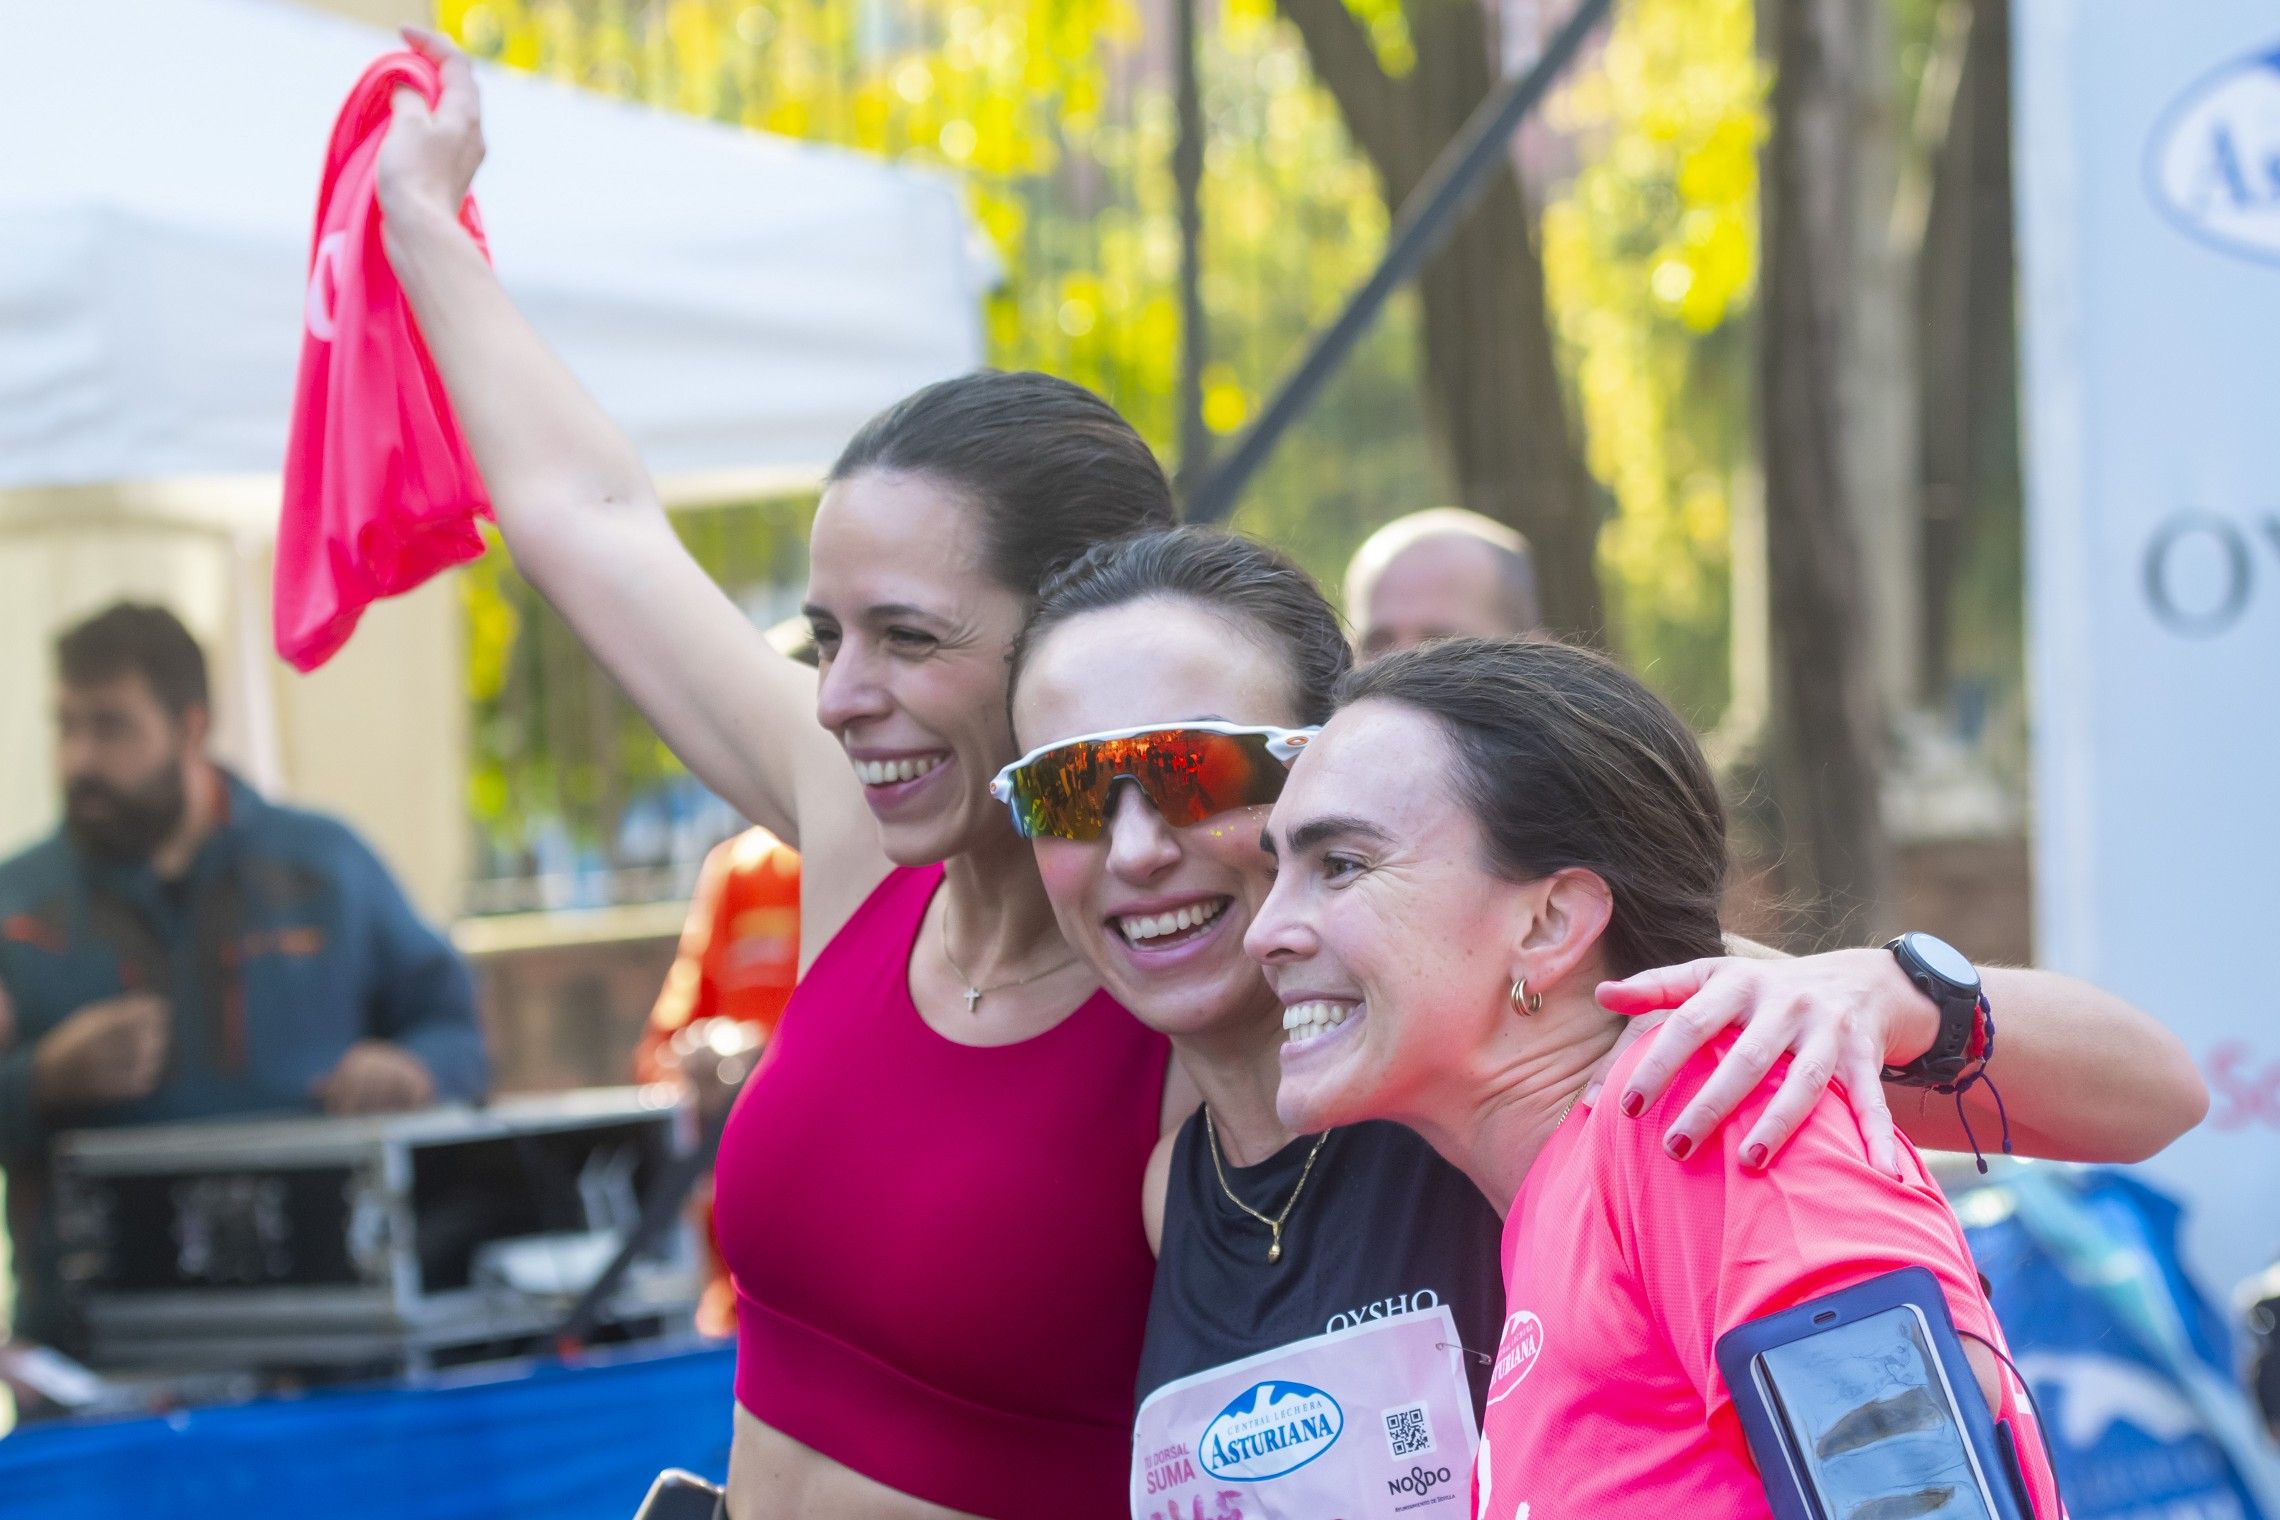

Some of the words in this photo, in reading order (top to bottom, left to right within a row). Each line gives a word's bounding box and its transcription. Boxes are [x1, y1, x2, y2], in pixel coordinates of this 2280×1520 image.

[1326, 1289, 1438, 1334] OYSHO
[1227, 1415, 1270, 1435] CENTRAL
[1274, 1400, 1322, 1420] LECHERA
[1154, 1443, 1190, 1465] DORSAL
[1212, 1413, 1334, 1470] ASTURIANA
[1147, 1458, 1196, 1494] SUMA
